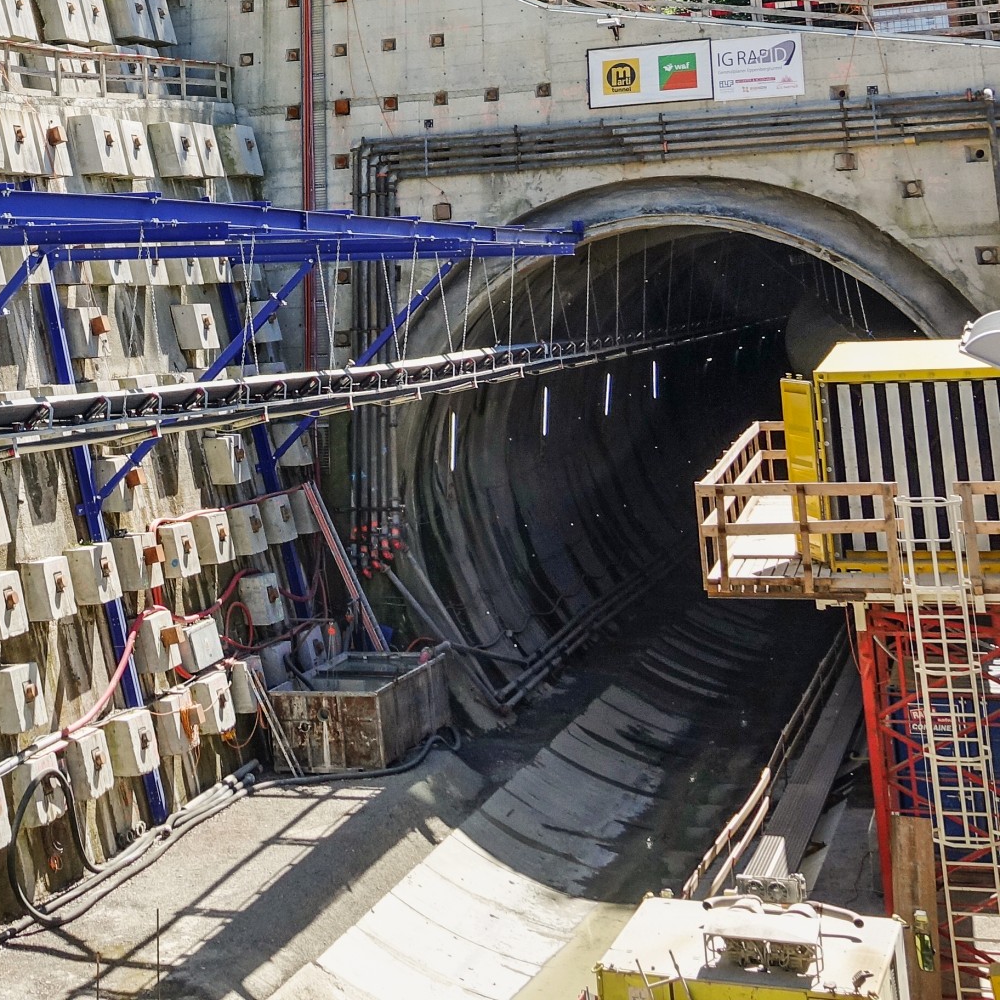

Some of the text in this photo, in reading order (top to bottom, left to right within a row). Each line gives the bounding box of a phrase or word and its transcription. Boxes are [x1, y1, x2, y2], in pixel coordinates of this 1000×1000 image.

[717, 46, 787, 67] IG RAPID
[674, 62, 690, 71] waf
